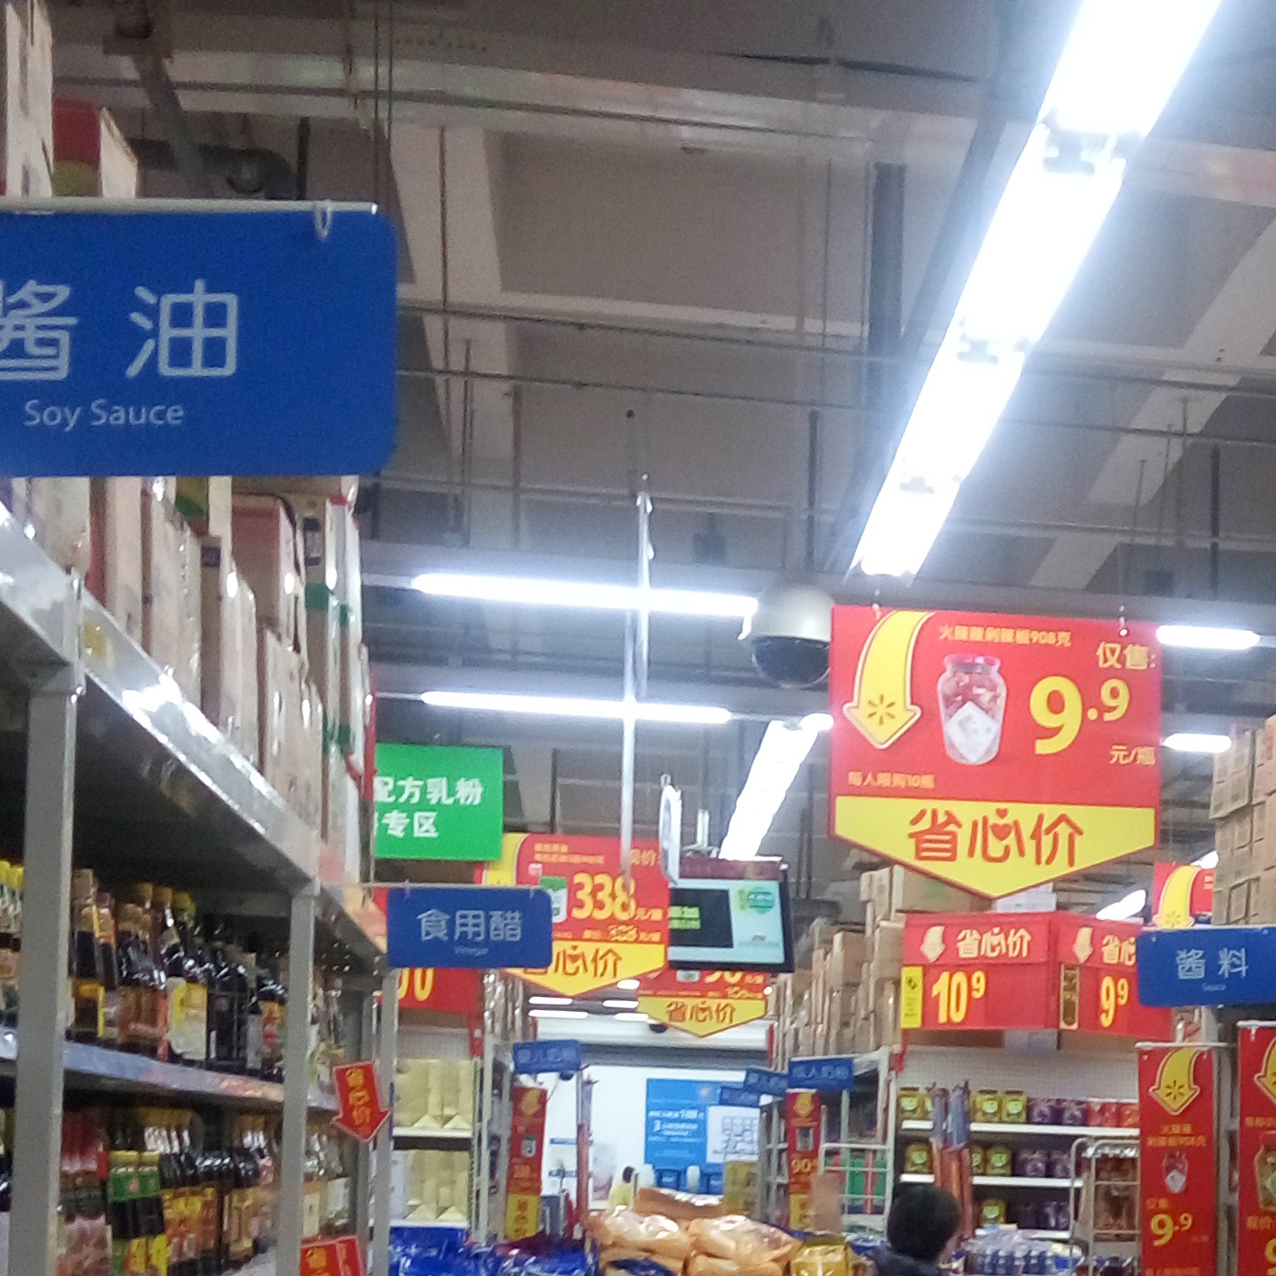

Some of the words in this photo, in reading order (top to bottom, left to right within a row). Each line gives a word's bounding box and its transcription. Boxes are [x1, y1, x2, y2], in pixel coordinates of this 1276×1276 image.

[0, 278, 239, 381] 酱油
[23, 400, 82, 431] Soy
[90, 399, 185, 426] Sauce
[374, 809, 439, 838] 专区
[908, 807, 1084, 868] 省心价
[416, 907, 522, 942] 食用醋
[955, 926, 1032, 959] 省心价
[523, 944, 623, 980] 心价
[1175, 947, 1250, 981] 酱料
